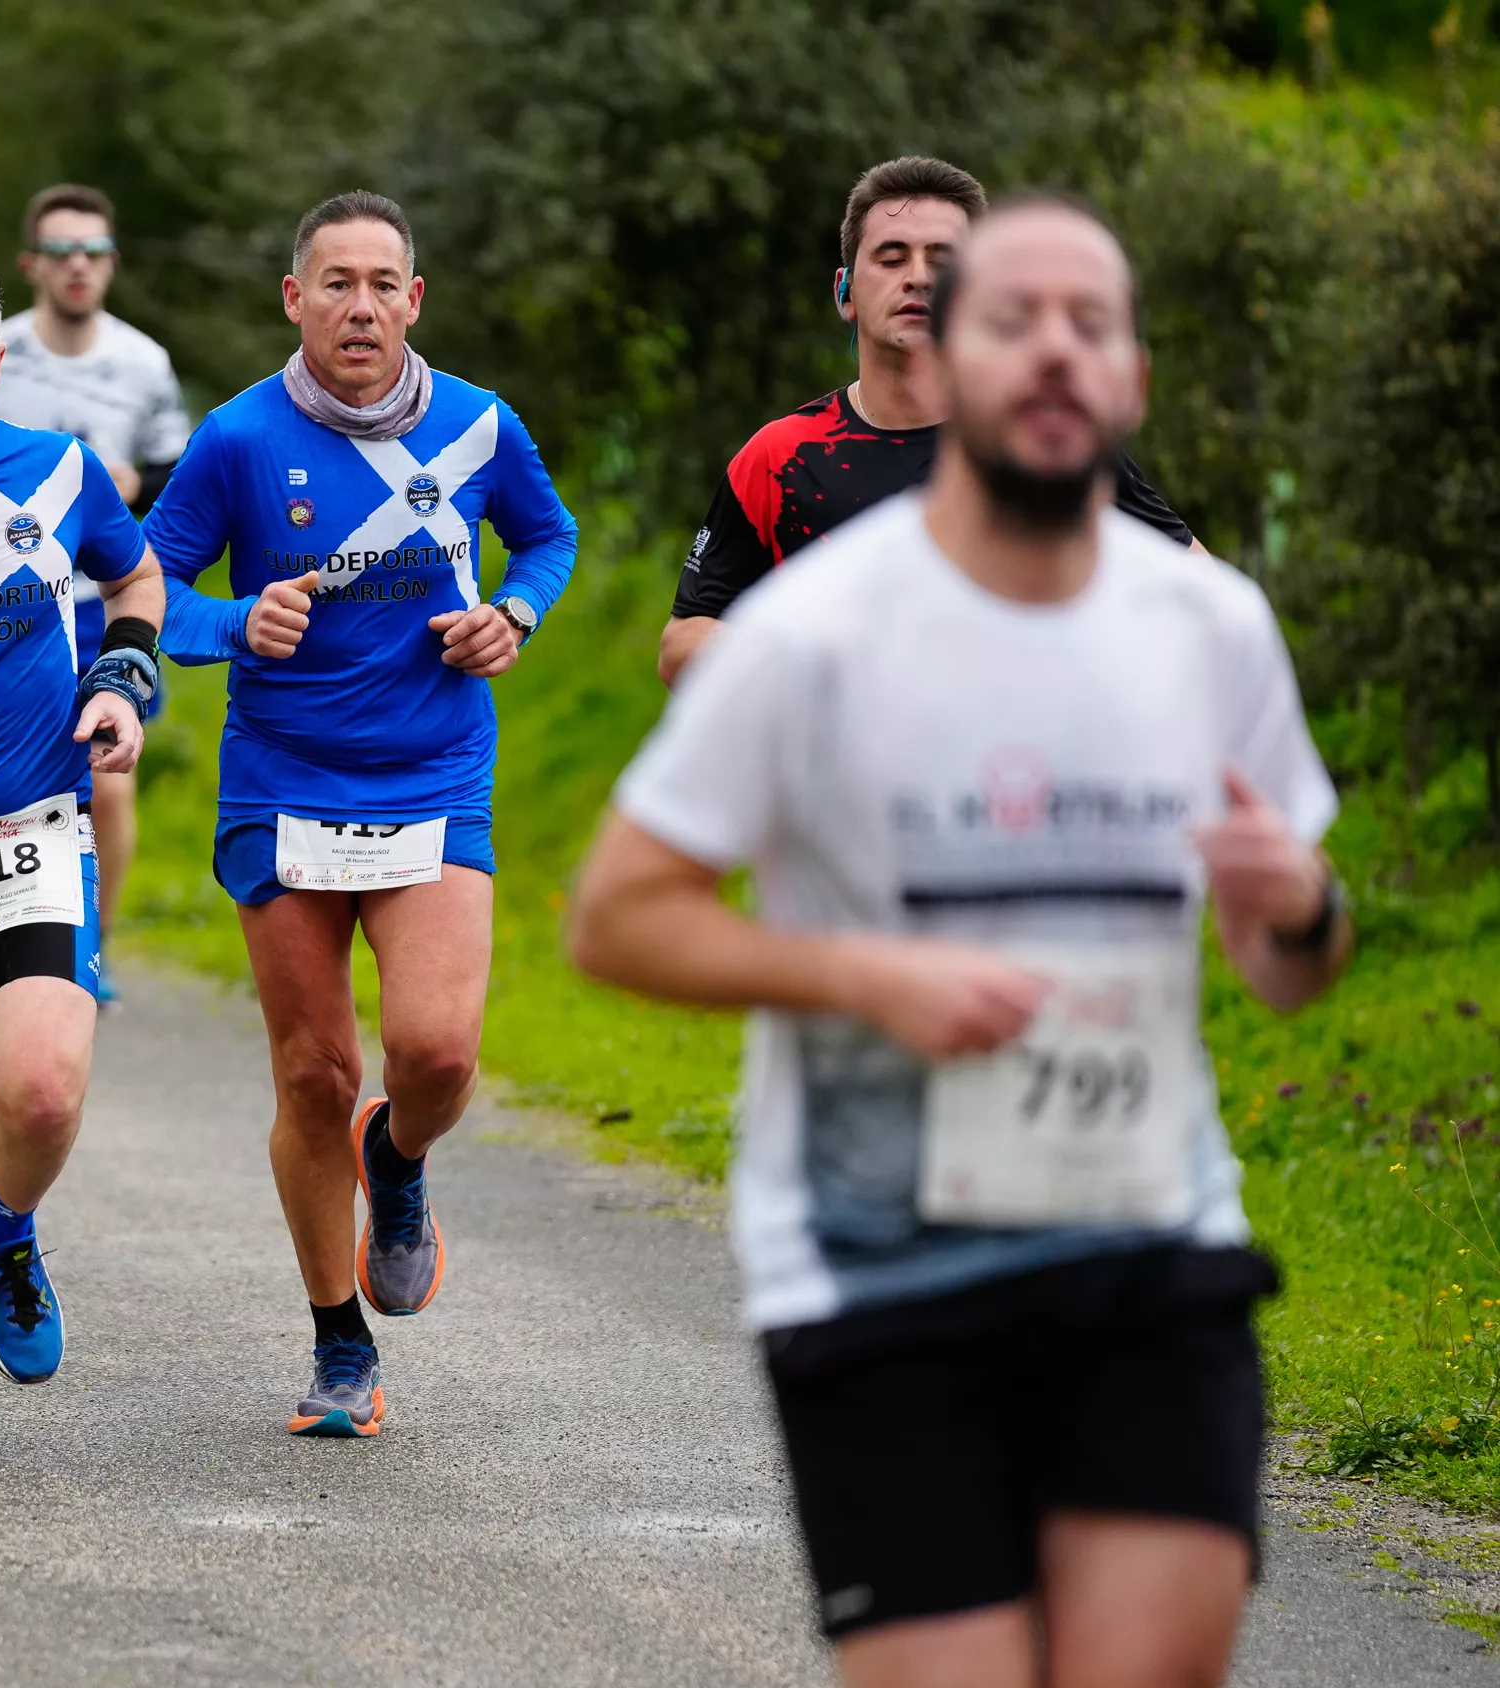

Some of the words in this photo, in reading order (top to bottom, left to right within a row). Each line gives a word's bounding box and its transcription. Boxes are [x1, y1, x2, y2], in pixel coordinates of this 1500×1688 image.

[409, 491, 438, 500] AXARLÓN
[9, 528, 40, 540] AXARLÓN
[262, 548, 320, 574] CLUB
[326, 541, 468, 573] DEPORTIVO
[306, 576, 430, 604] AXARLÓN
[1016, 1048, 1152, 1127] 799
